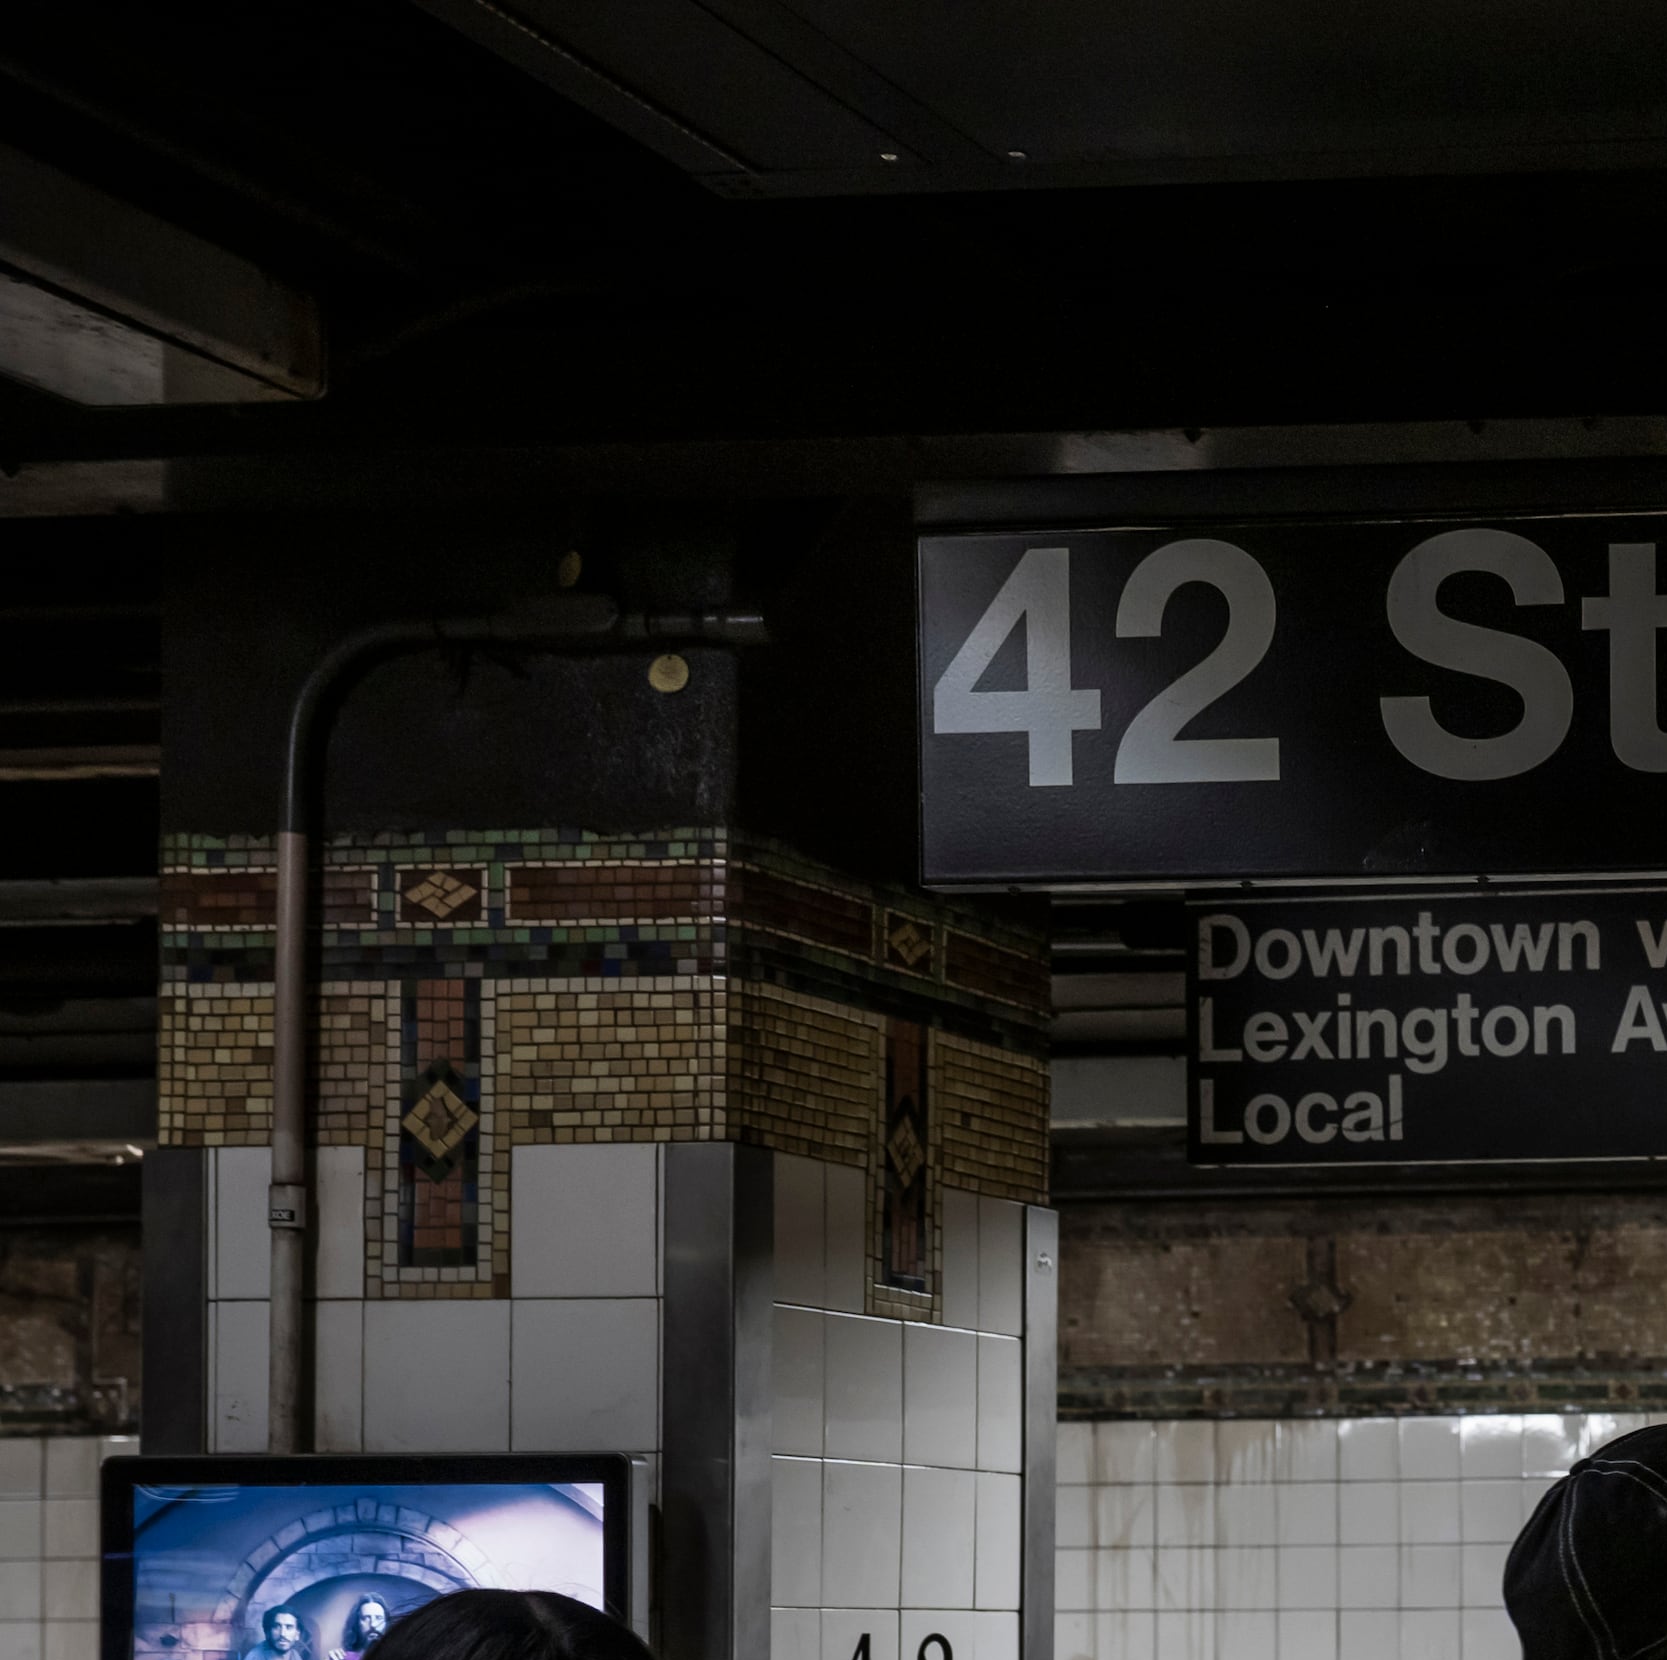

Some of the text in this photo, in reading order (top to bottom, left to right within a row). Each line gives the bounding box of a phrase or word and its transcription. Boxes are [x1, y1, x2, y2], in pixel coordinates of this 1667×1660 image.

[926, 544, 1281, 788] 42
[1202, 909, 1601, 980] Downtown
[1201, 992, 1577, 1075] Lexington
[1200, 1073, 1404, 1145] Local
